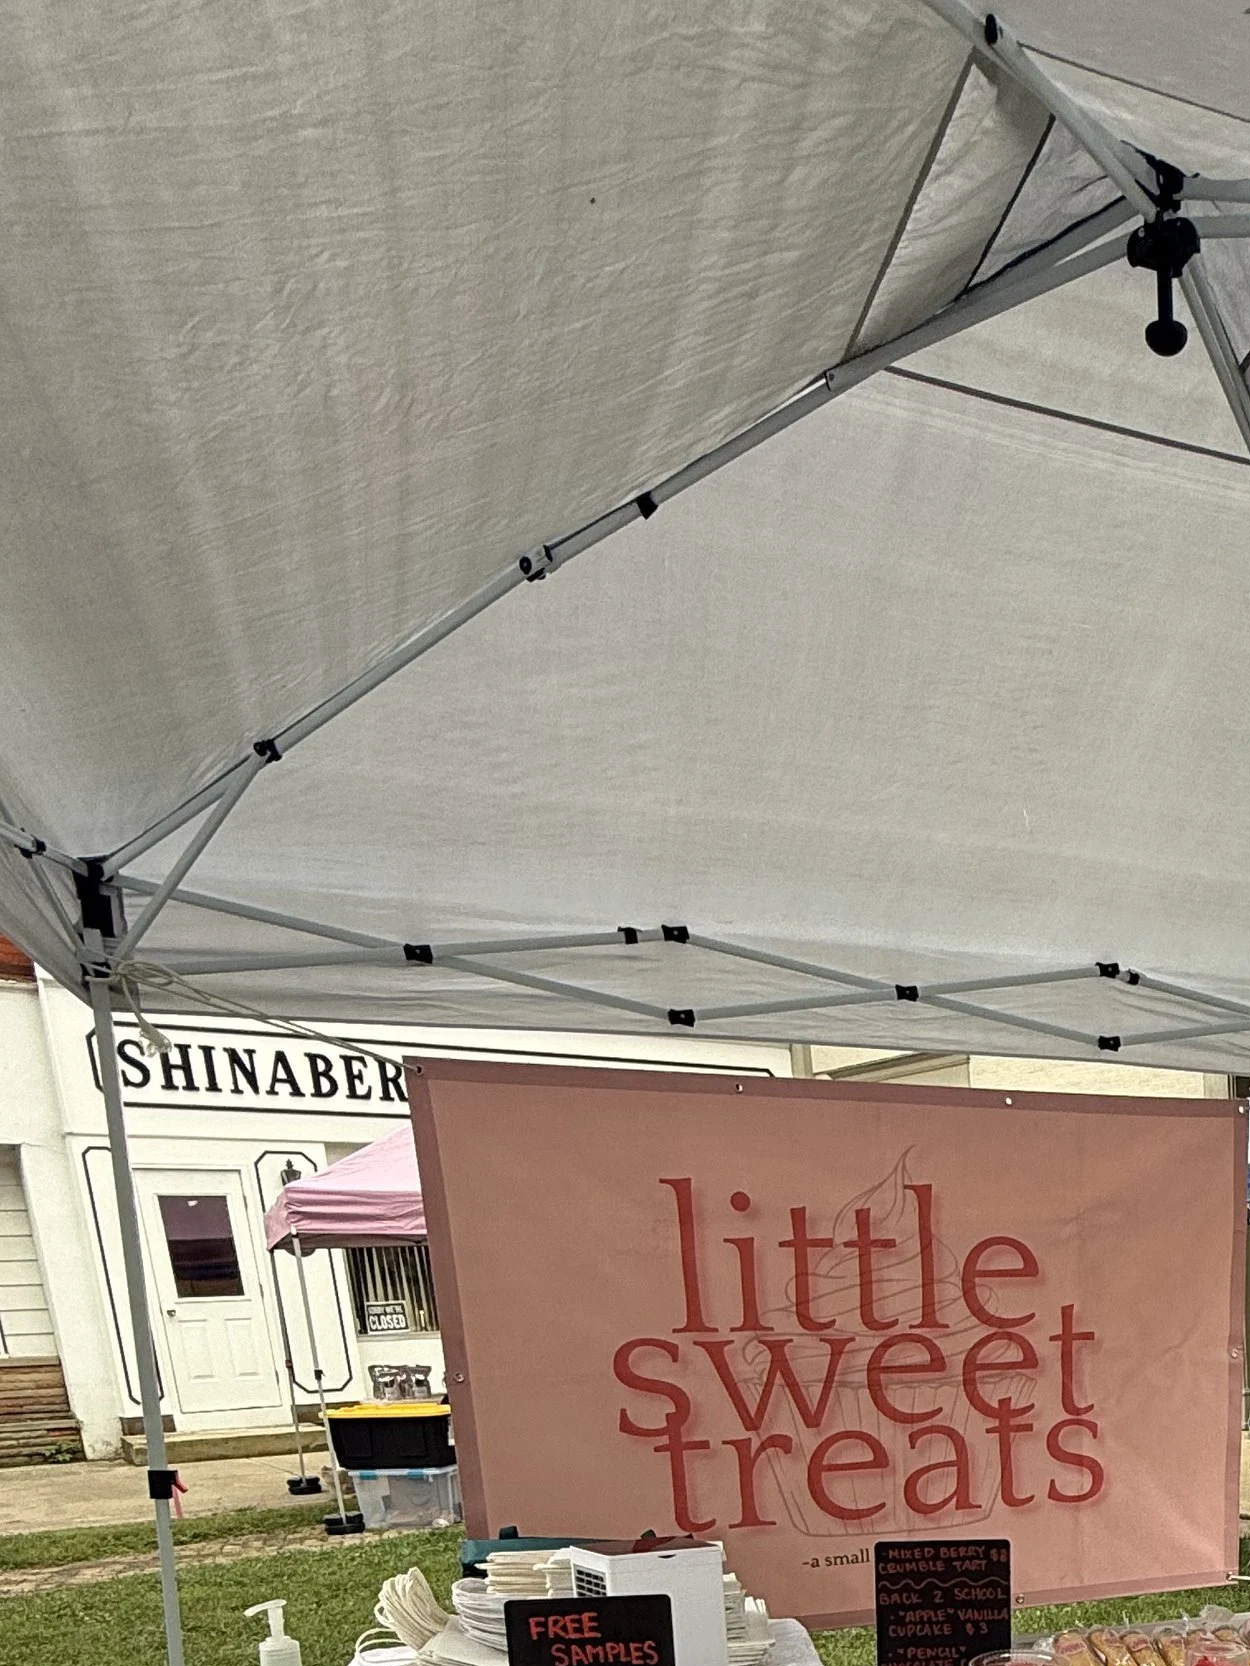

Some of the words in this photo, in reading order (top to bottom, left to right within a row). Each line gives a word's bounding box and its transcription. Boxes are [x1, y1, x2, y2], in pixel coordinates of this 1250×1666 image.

[659, 1178, 1039, 1333] little
[370, 1314, 406, 1330] CLOSED
[613, 1304, 1095, 1438] sweet
[654, 1397, 1104, 1533] treats
[825, 1548, 870, 1567] small
[940, 1546, 985, 1558] BERRY
[879, 1560, 946, 1574] CRUMBLE
[952, 1560, 988, 1572] TART
[879, 1593, 922, 1605] BACK
[933, 1591, 944, 1603] 2
[954, 1587, 1007, 1600] SCHOOL
[957, 1607, 1009, 1621] VANILLA
[529, 1612, 602, 1640] FREE
[888, 1623, 953, 1638] CUPCAKE
